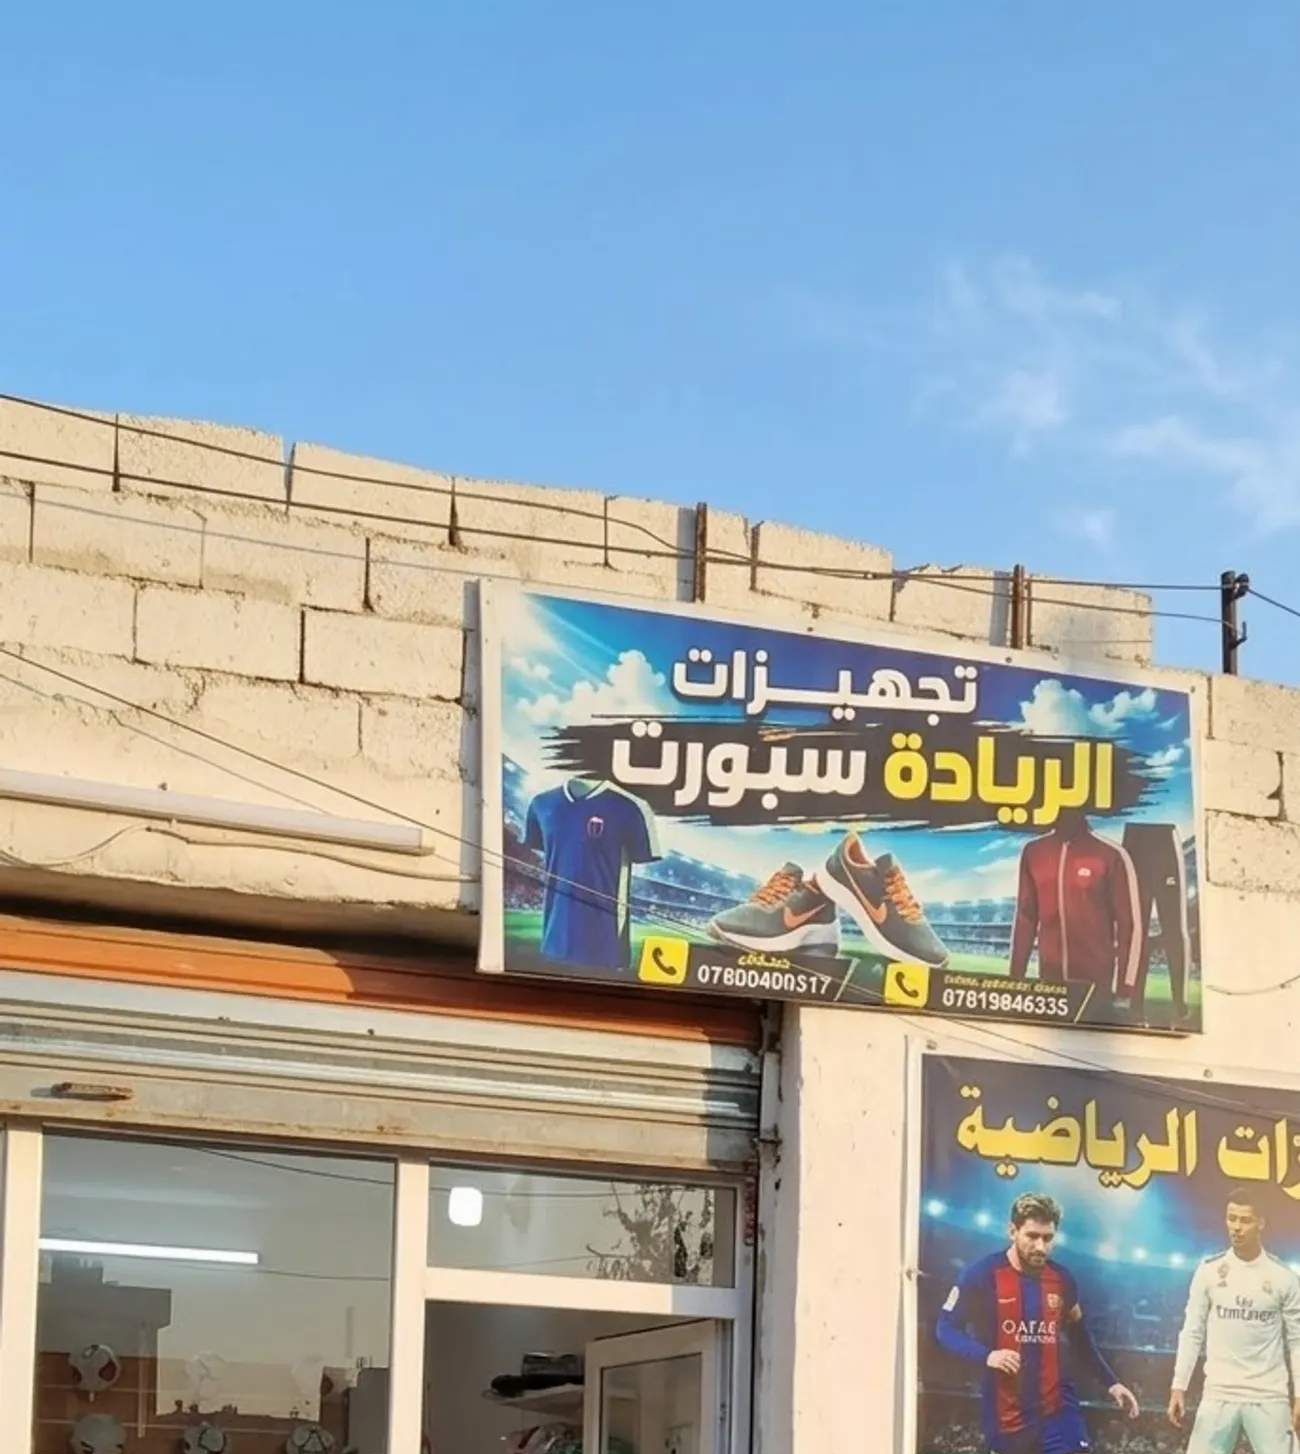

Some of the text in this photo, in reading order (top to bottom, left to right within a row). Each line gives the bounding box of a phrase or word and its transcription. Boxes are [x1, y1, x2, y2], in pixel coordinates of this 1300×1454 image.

[673, 648, 979, 725] تجهيزات
[611, 720, 1113, 825] الريادة سبورت
[942, 988, 1069, 1016] 07819846335
[957, 1084, 1198, 1189] الرياضية
